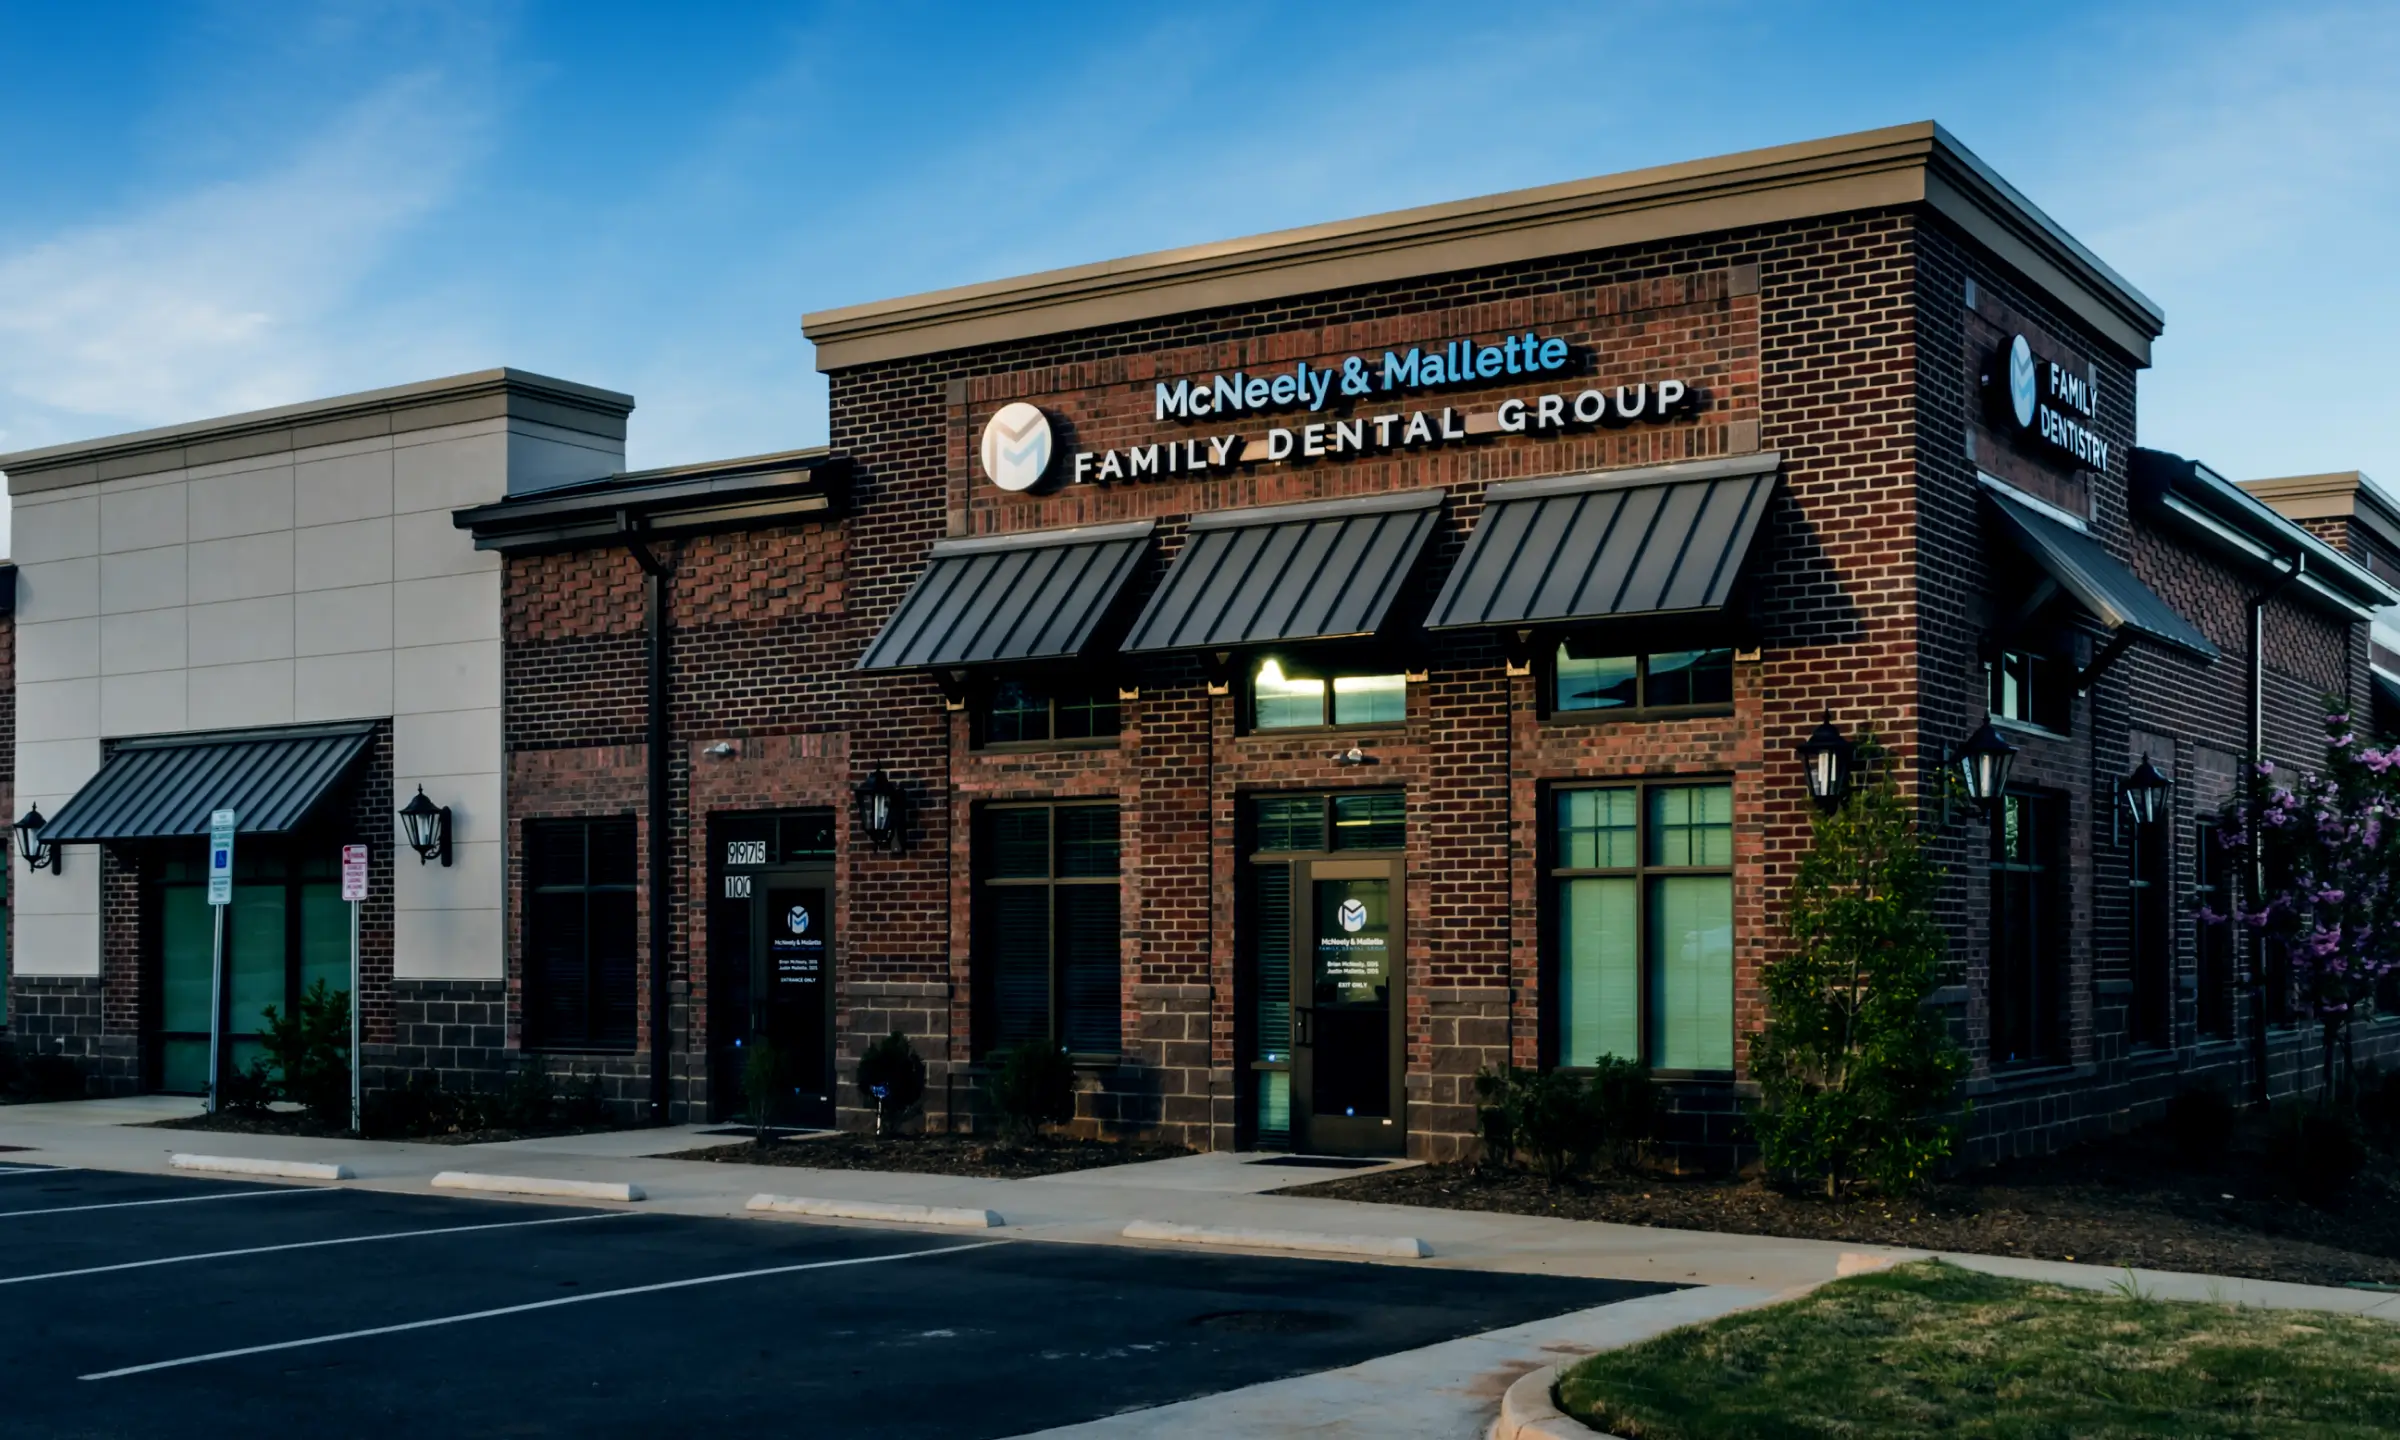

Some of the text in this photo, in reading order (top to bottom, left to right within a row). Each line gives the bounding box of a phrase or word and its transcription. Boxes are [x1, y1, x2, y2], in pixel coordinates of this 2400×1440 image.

[1156, 333, 1568, 420] McNeely & Mallette
[2051, 362, 2097, 419] FAMILY
[1074, 379, 1685, 483] FAMILY DENTAL GROUP
[2040, 403, 2108, 472] DENTISTRY
[728, 842, 765, 864] 9975
[726, 876, 751, 898] 100
[1321, 937, 1350, 946] McNeely
[1356, 937, 1384, 945] Mallette
